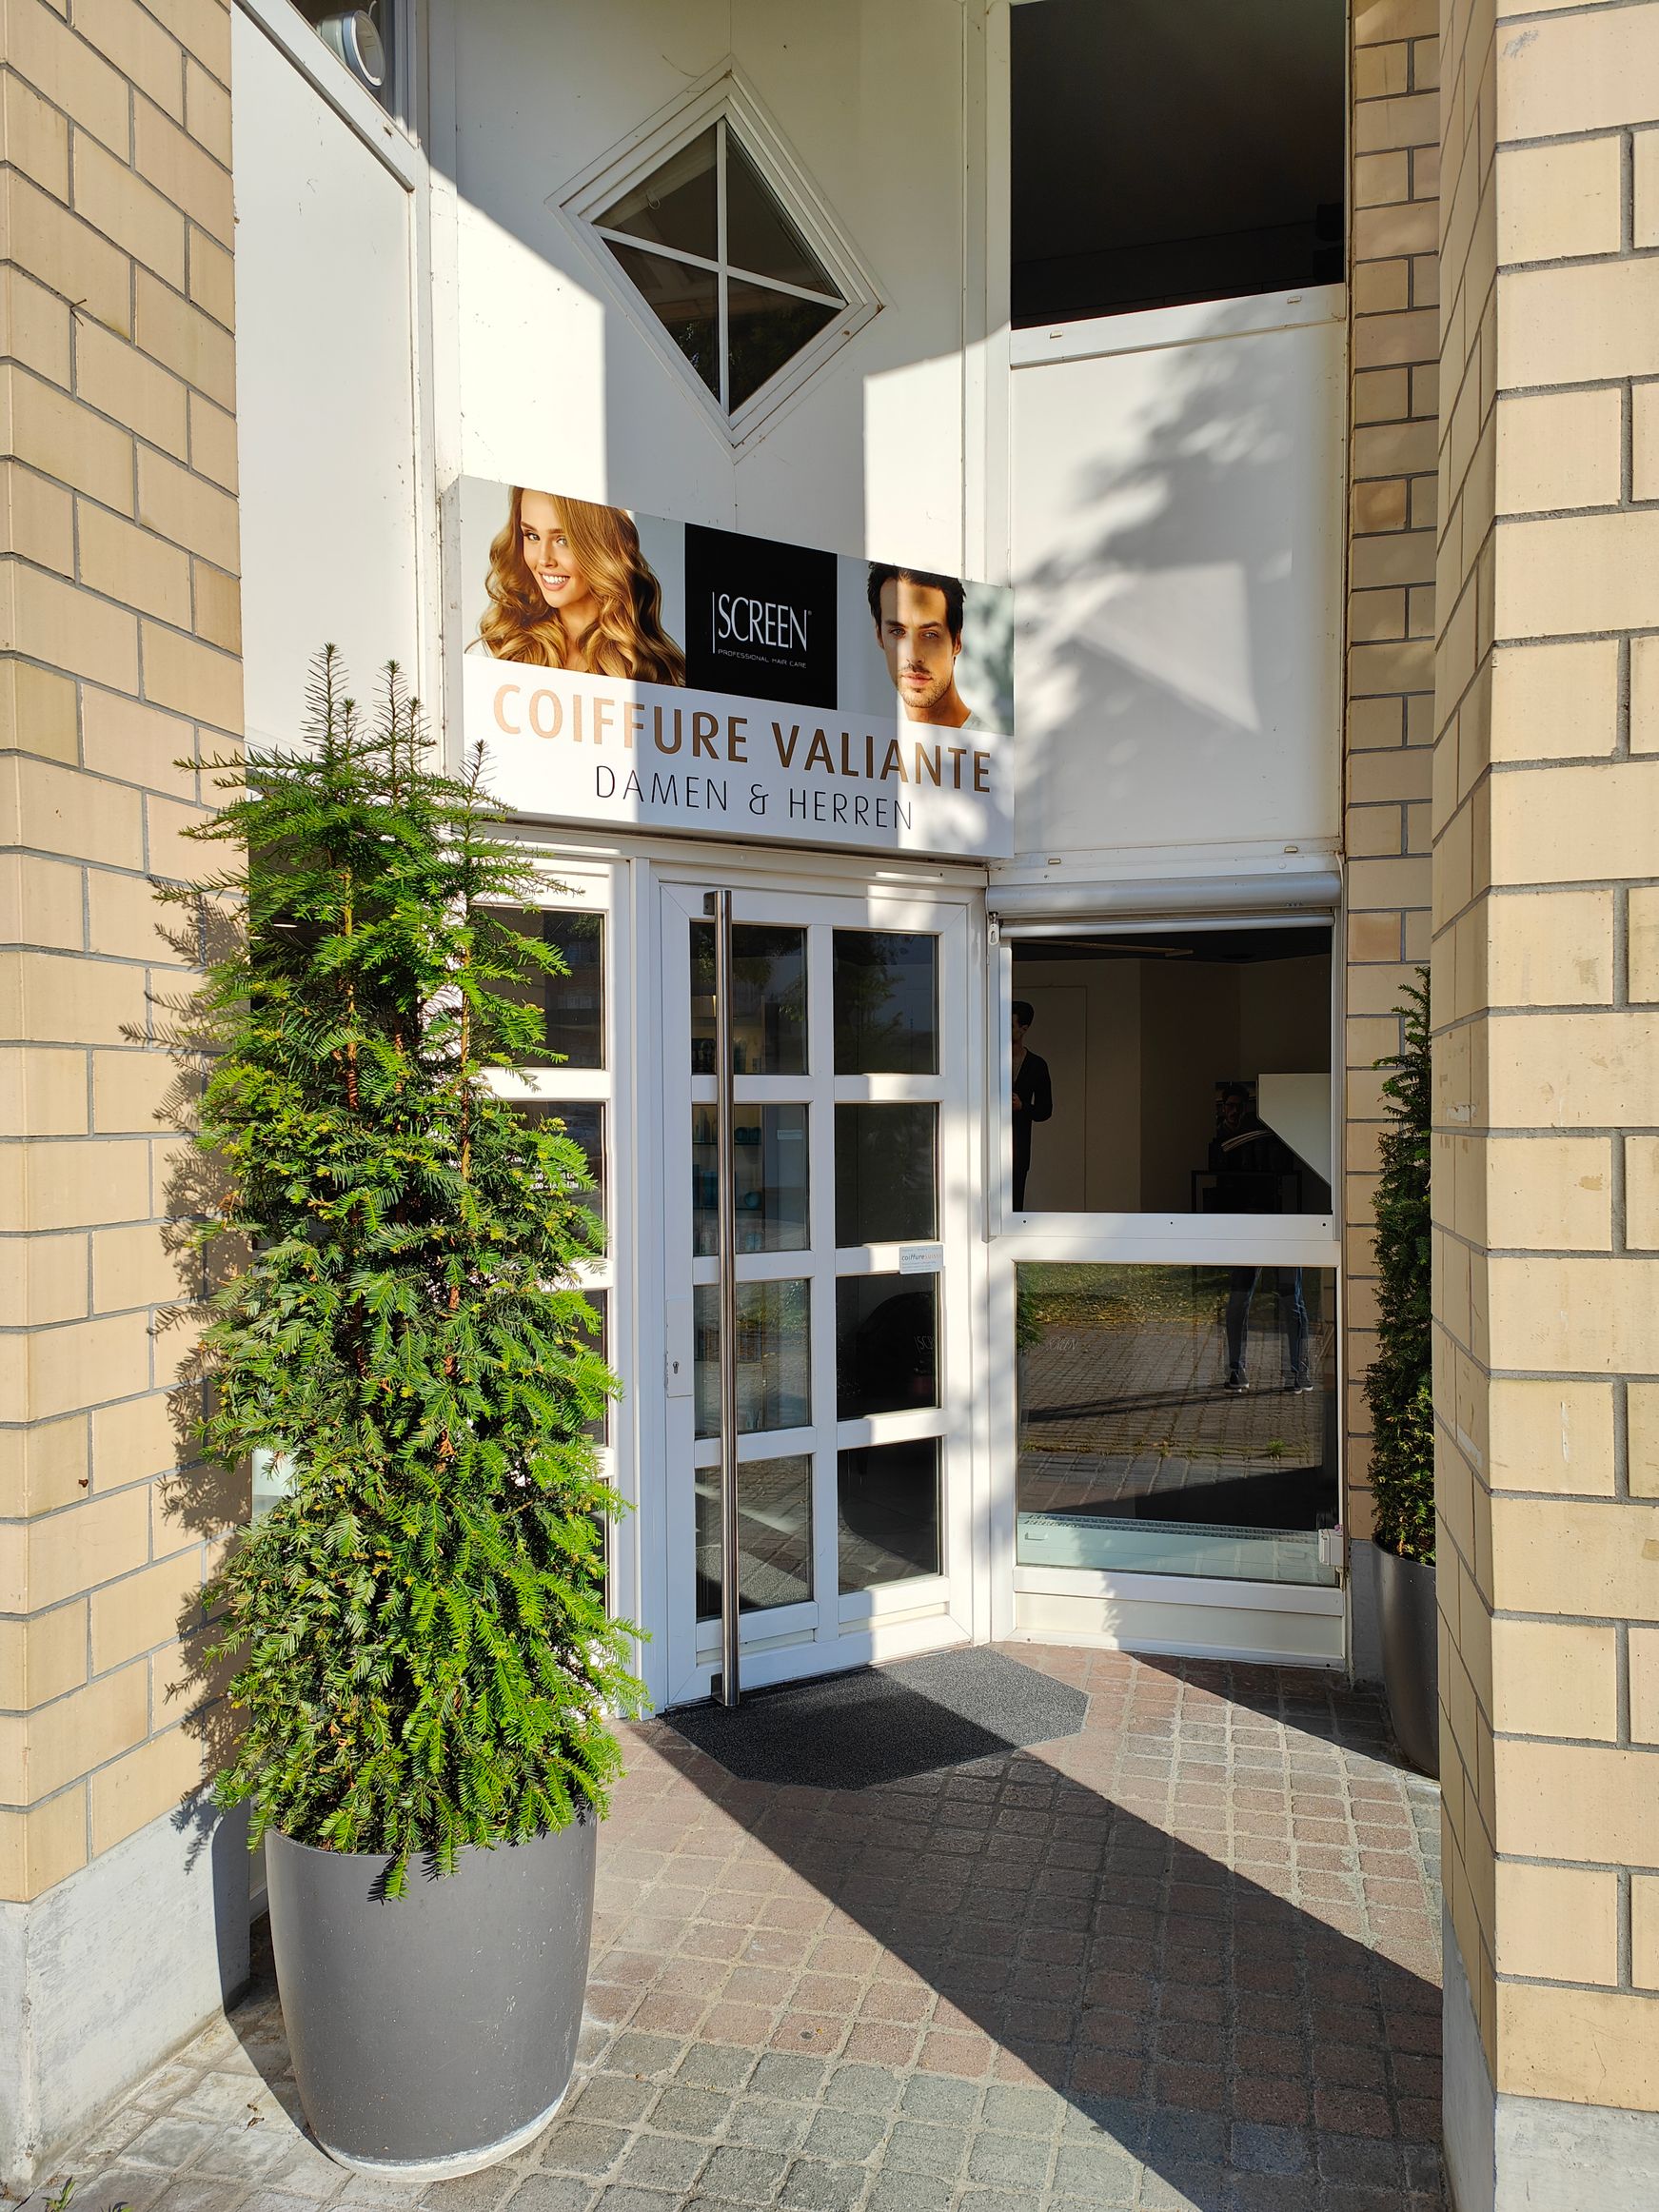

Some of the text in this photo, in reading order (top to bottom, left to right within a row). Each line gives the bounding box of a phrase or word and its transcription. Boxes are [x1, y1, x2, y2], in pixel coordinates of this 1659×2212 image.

[718, 593, 807, 652] SCREEN
[718, 648, 769, 663] PROFESSIONAL
[789, 661, 807, 669] CARE
[493, 683, 991, 793] COIFFURE VALIANTE
[596, 764, 912, 830] DAMEN & HERREN
